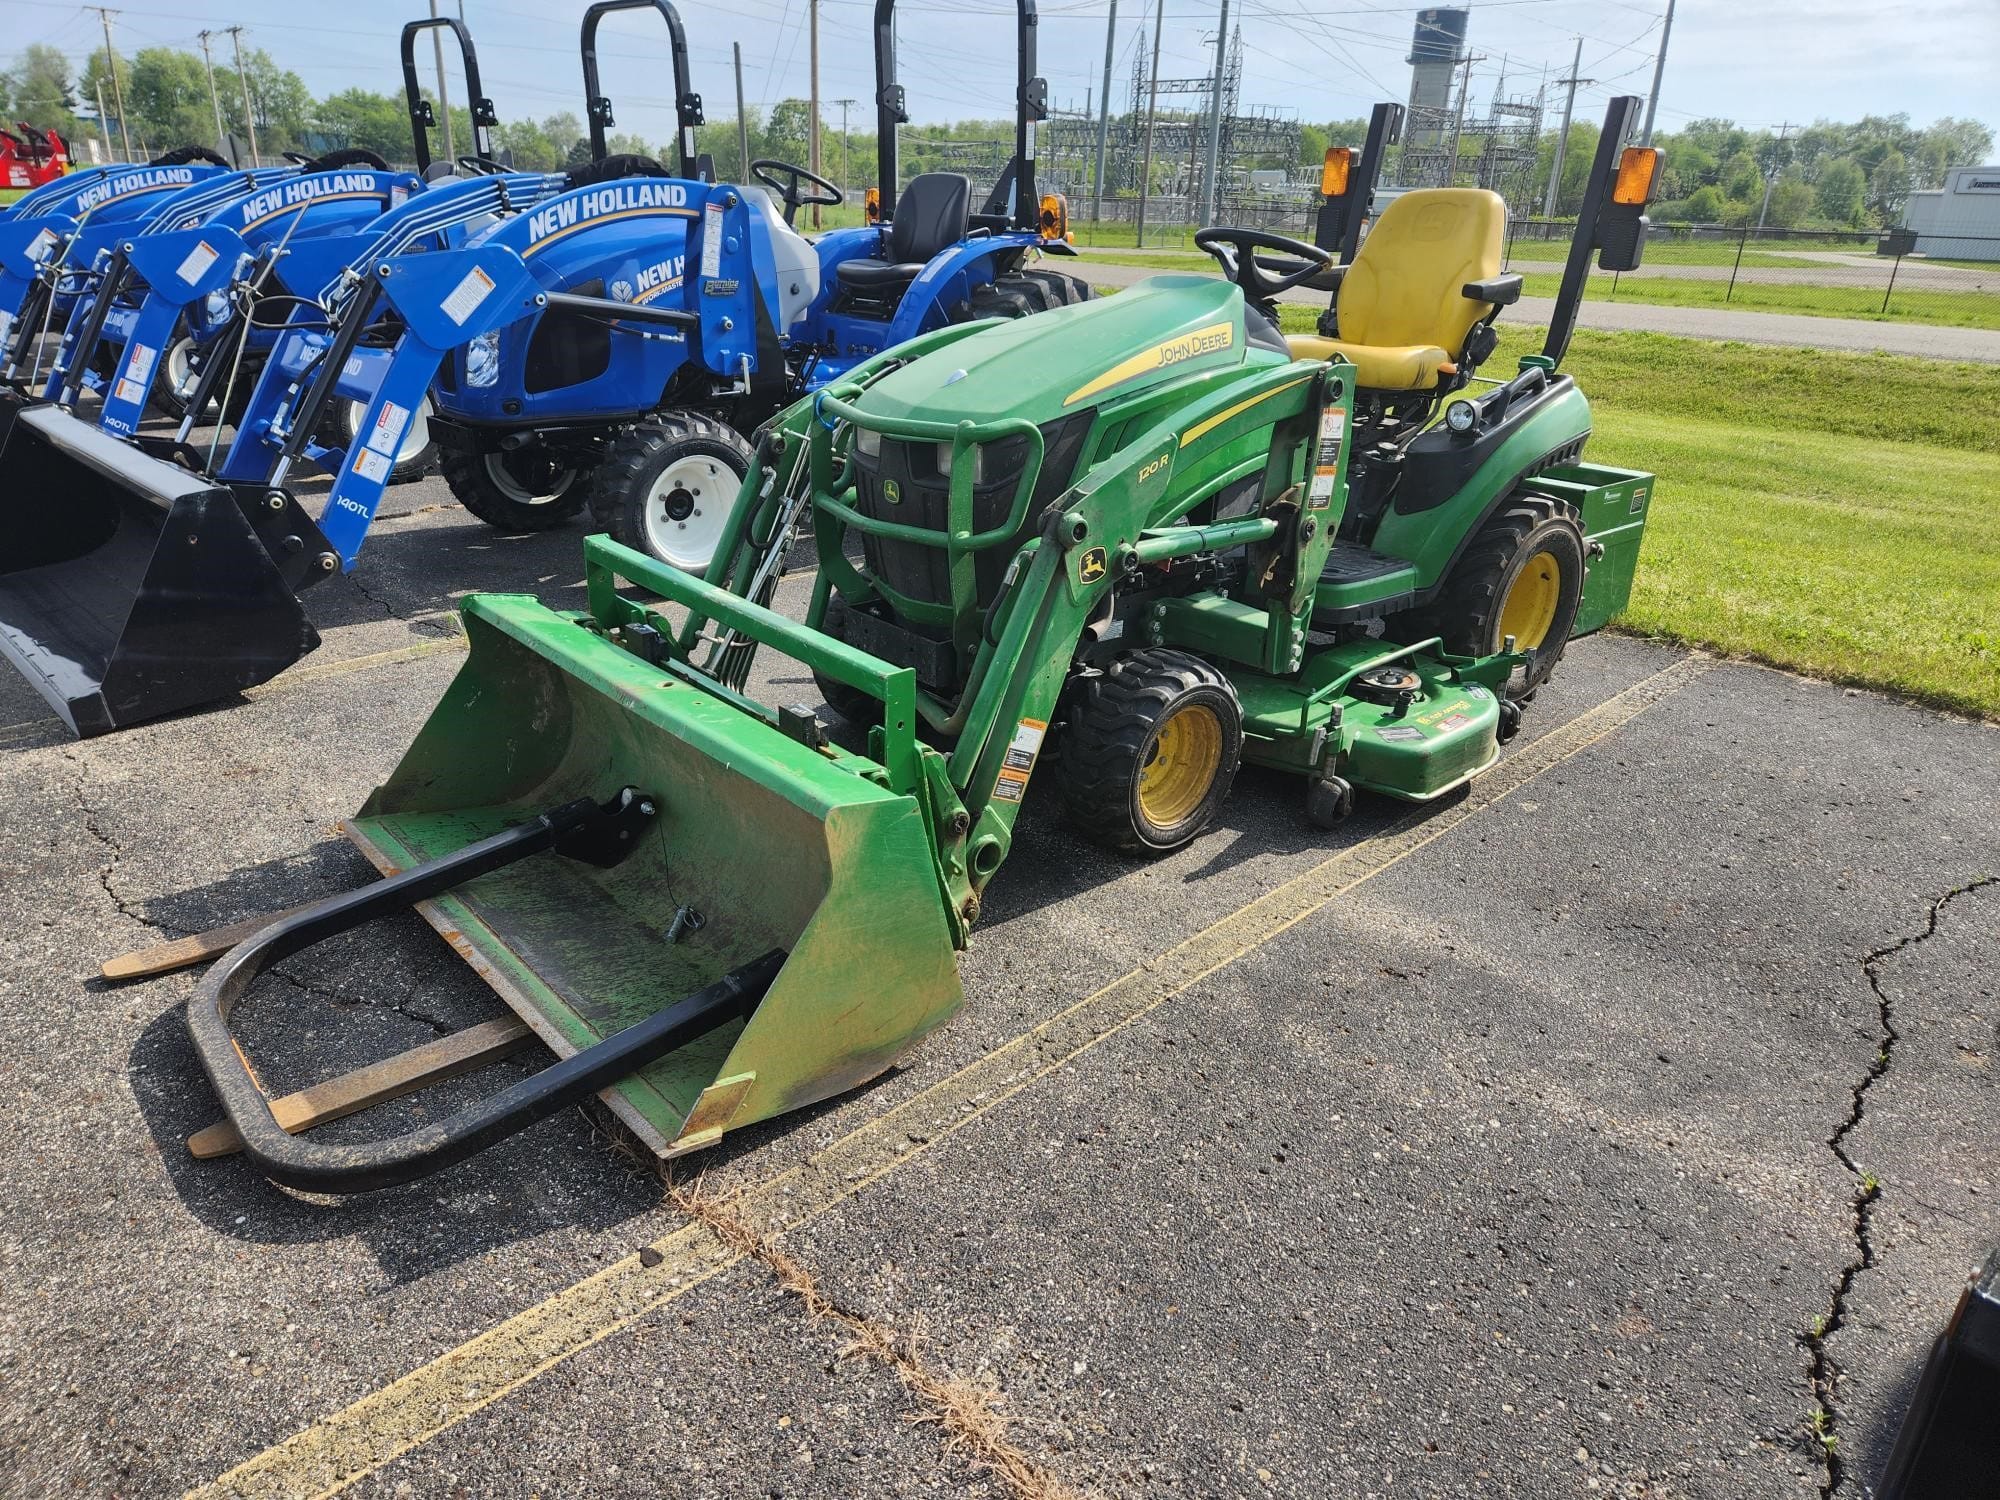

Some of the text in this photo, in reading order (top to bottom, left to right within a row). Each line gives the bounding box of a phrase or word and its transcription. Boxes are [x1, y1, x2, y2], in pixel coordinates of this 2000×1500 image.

[76, 169, 193, 212] NEW HOLLAND
[242, 184, 283, 224] NEW
[285, 174, 375, 204] HOLLAND
[529, 184, 687, 244] NEW HOLLAND
[636, 260, 673, 292] NEW
[641, 280, 684, 305] WORKMASTE
[1158, 332, 1229, 365] JOHN DEERE
[104, 415, 132, 433] 140TL
[336, 494, 370, 519] 140TL
